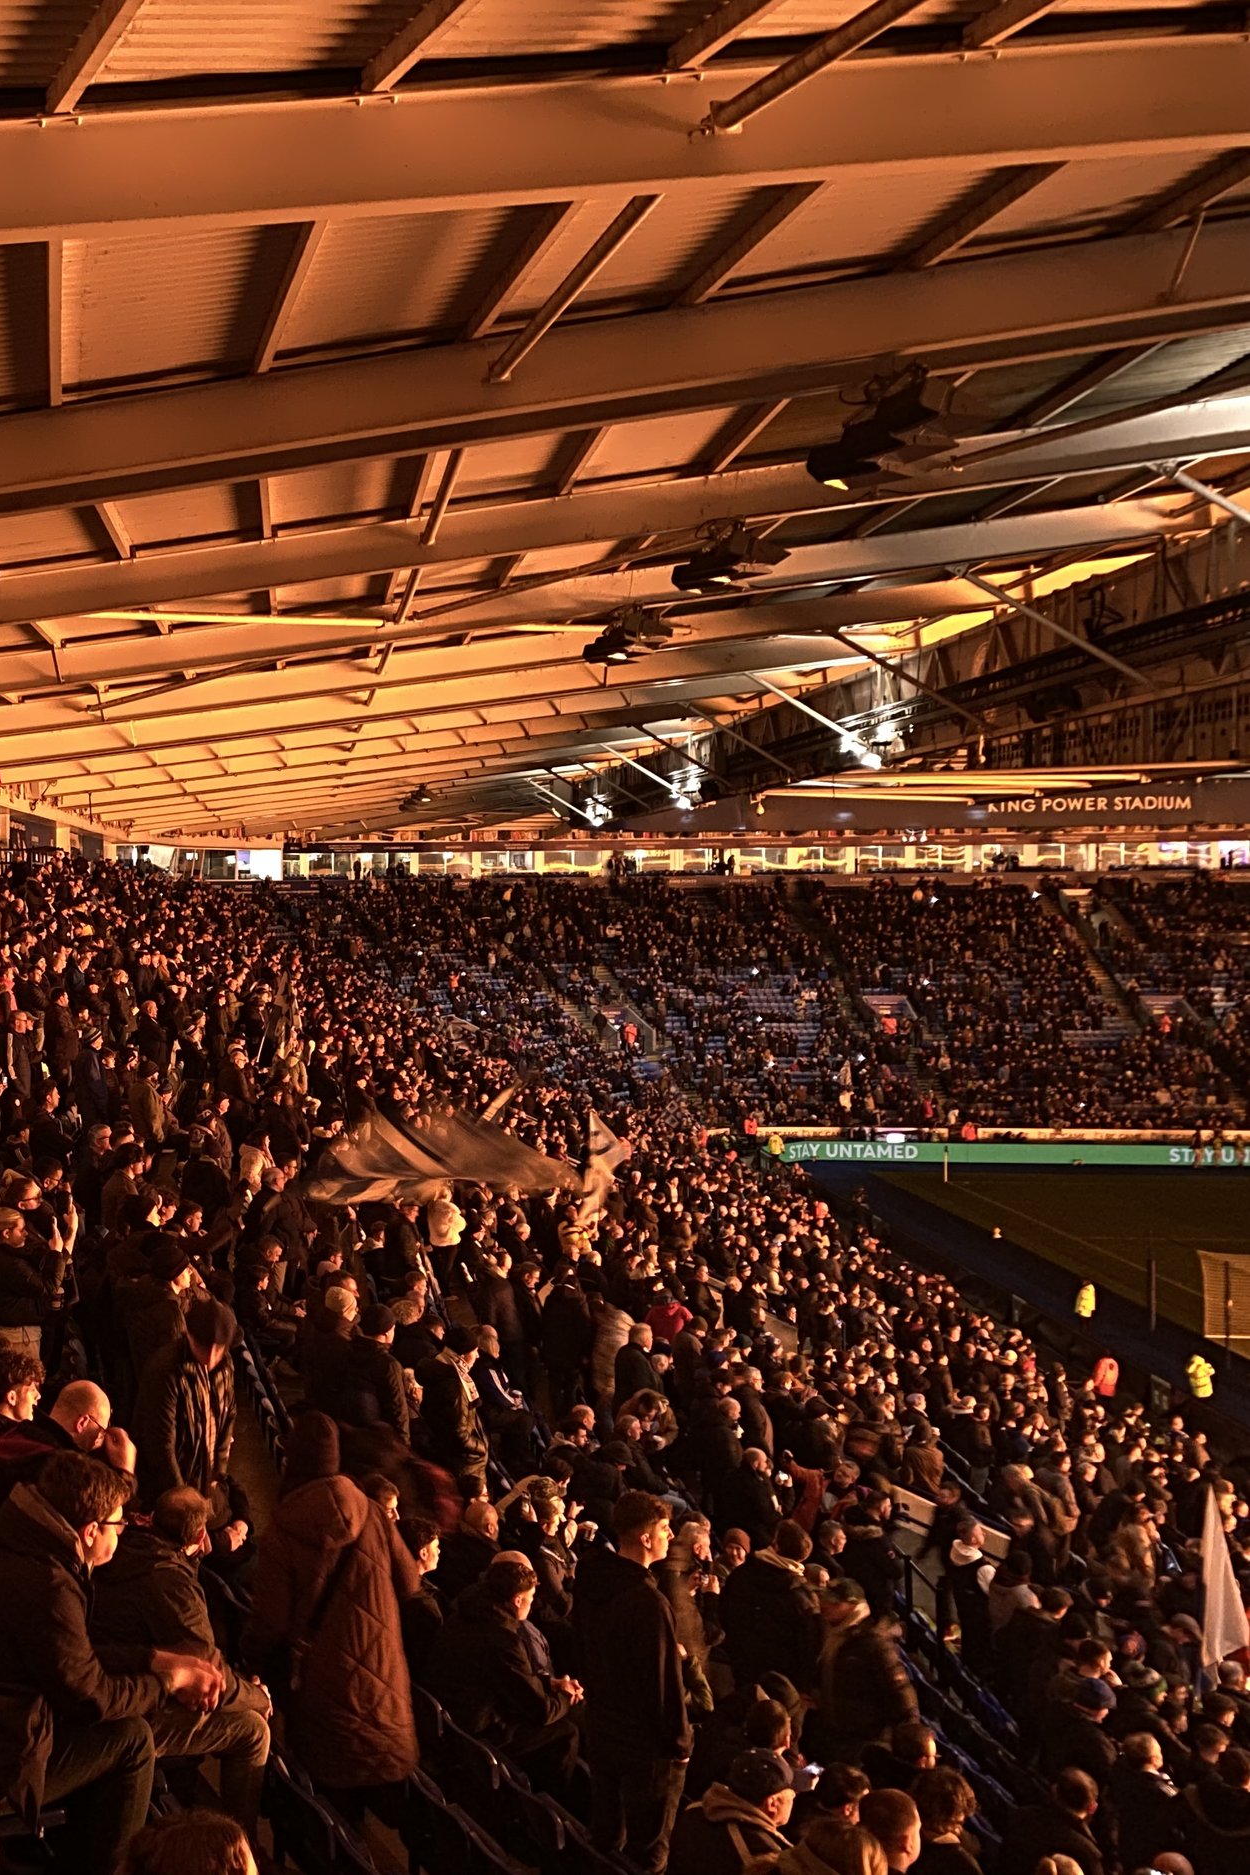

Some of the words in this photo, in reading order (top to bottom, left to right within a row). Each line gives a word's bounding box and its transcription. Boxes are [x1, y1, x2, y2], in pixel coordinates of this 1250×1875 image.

[1041, 797, 1108, 812] POWER
[1113, 796, 1193, 811] STADIUM
[789, 1143, 821, 1160] STAY
[825, 1143, 919, 1159] UNTAMED
[1169, 1147, 1215, 1163] STY
